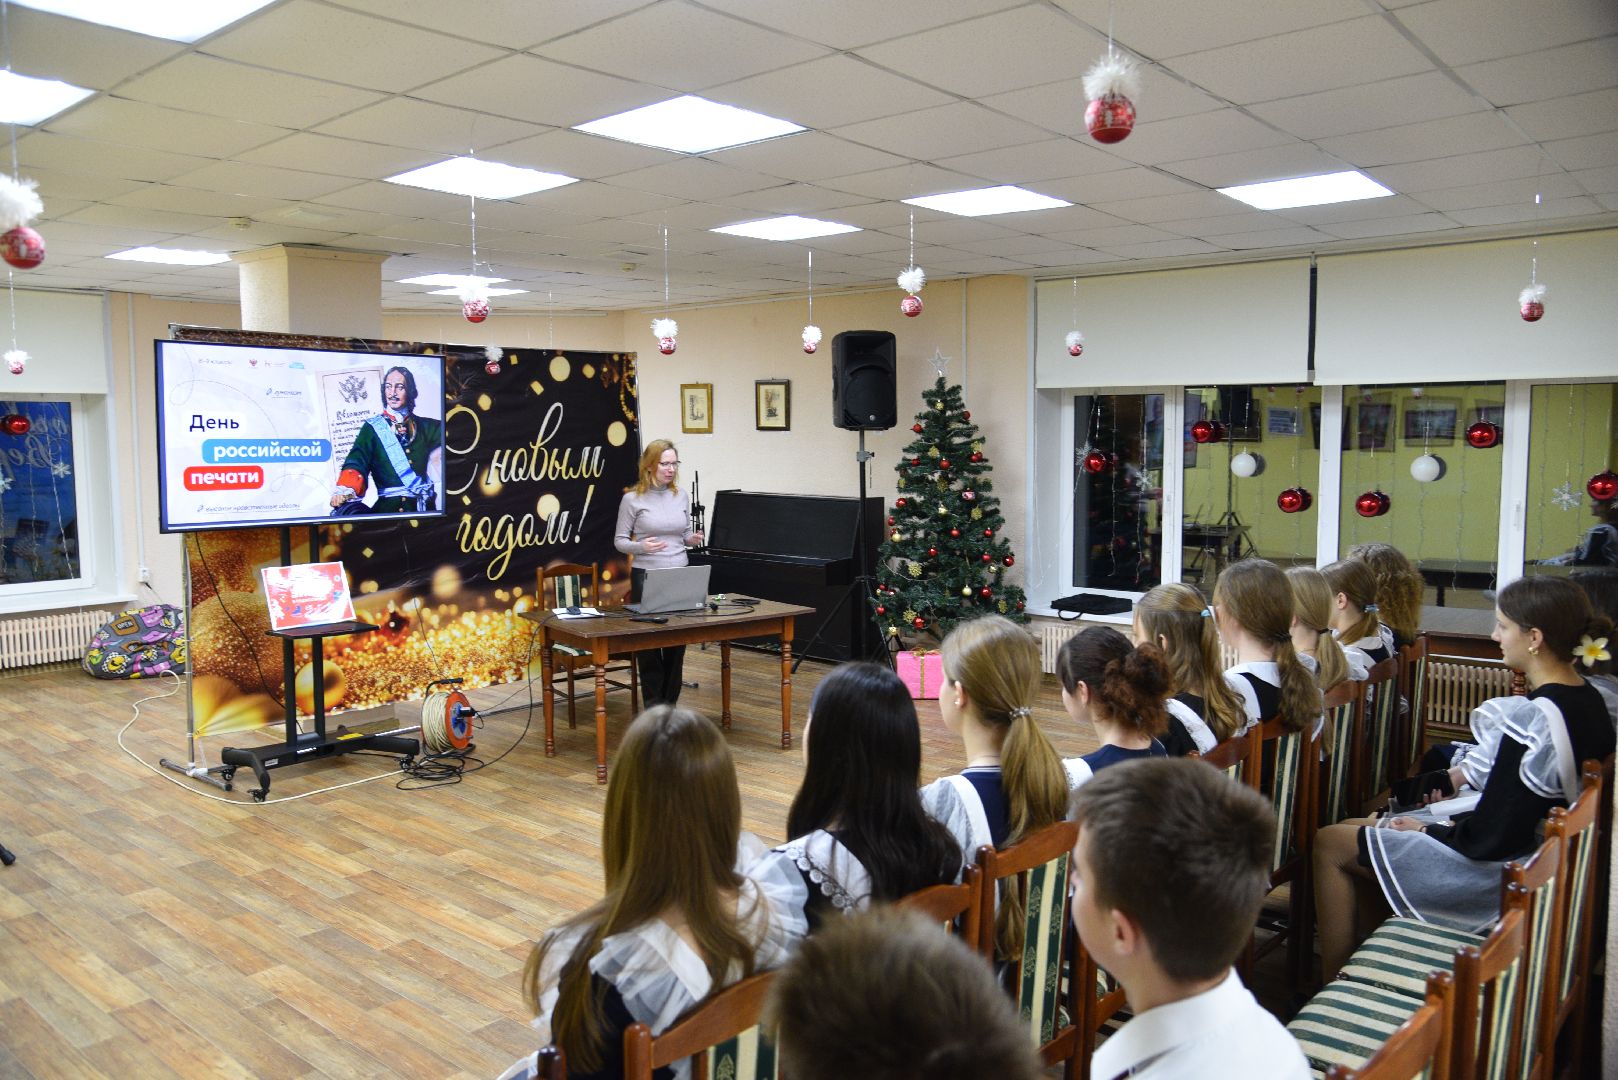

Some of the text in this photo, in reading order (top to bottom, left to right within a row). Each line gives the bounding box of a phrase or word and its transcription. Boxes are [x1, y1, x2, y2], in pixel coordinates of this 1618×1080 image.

[189, 414, 240, 432] День
[213, 441, 323, 461] российской
[485, 402, 605, 485] новым
[190, 469, 260, 486] печати
[455, 484, 595, 581] годом!
